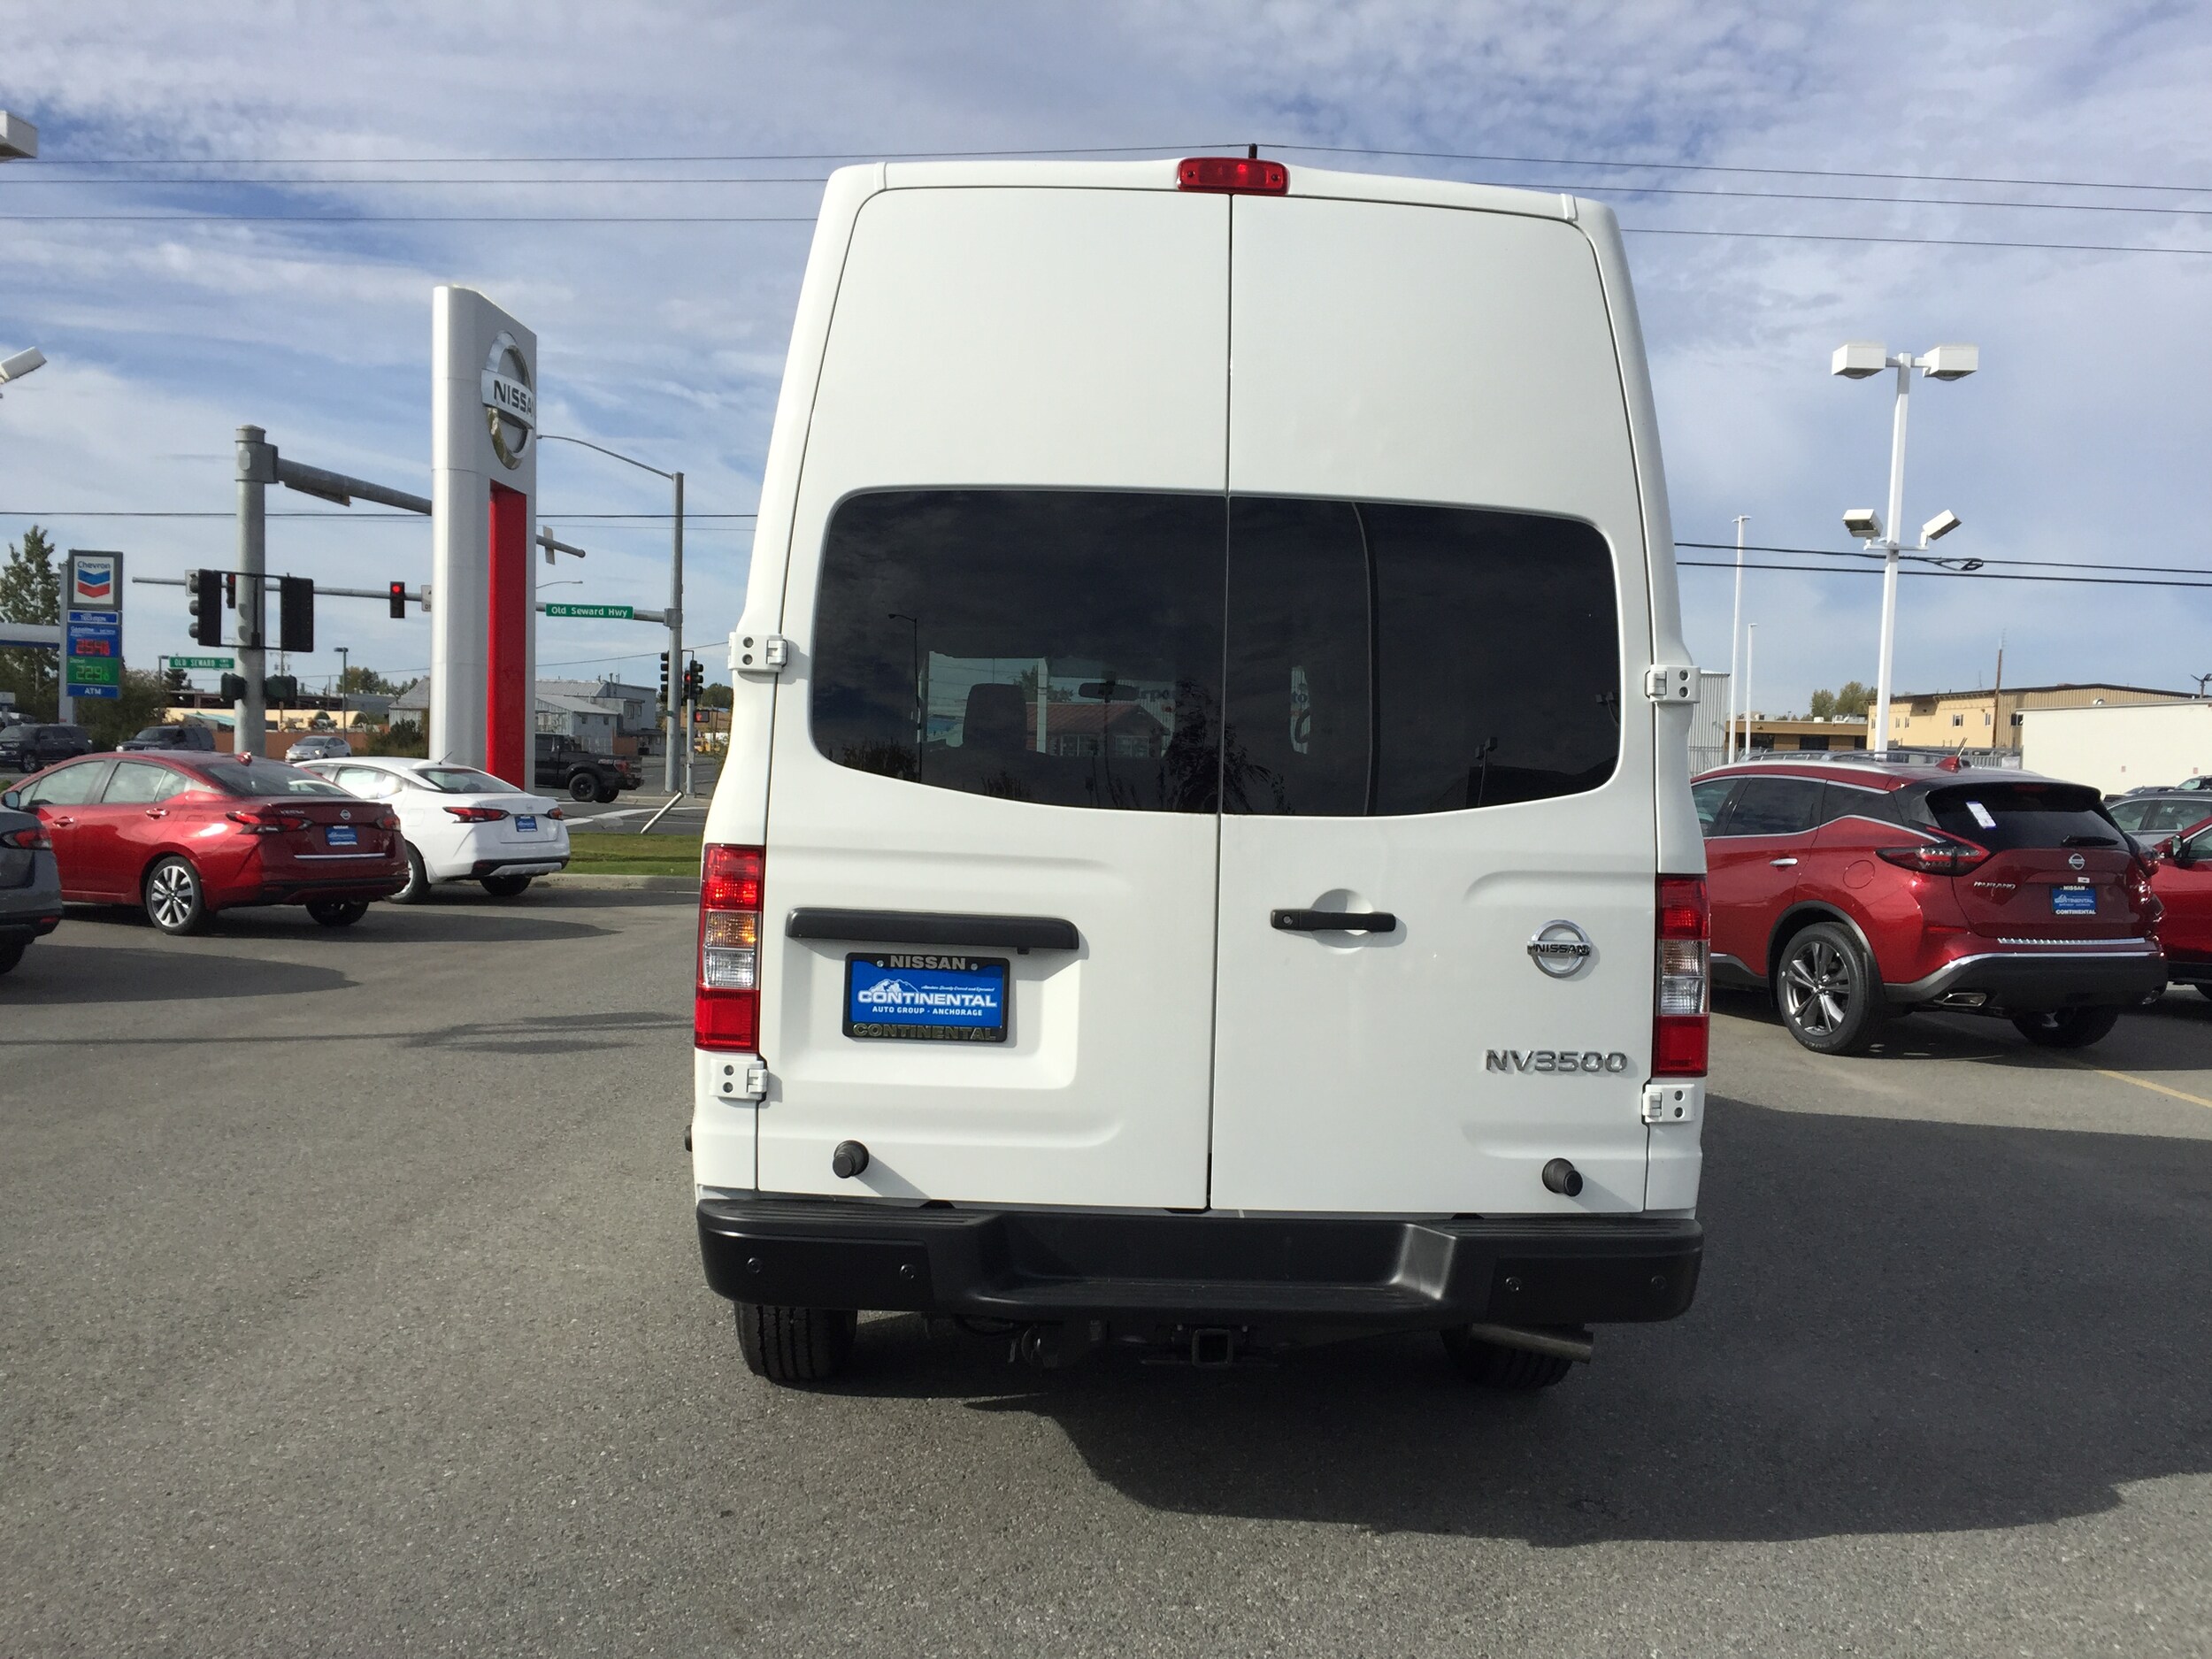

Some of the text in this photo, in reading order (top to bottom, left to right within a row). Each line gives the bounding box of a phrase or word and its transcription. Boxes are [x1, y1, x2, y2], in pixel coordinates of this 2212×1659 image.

[494, 380, 534, 418] NISSA
[551, 606, 627, 618] Old Seward Hwy
[190, 658, 215, 667] SEWARD
[1534, 943, 1590, 956] NISSAN
[890, 956, 966, 971] NISSAN
[858, 990, 997, 1008] CONTINENTAL
[933, 1008, 983, 1017] ANCHORAGE
[853, 1023, 996, 1041] CONTINENTAL
[1486, 1049, 1628, 1072] NV3500
